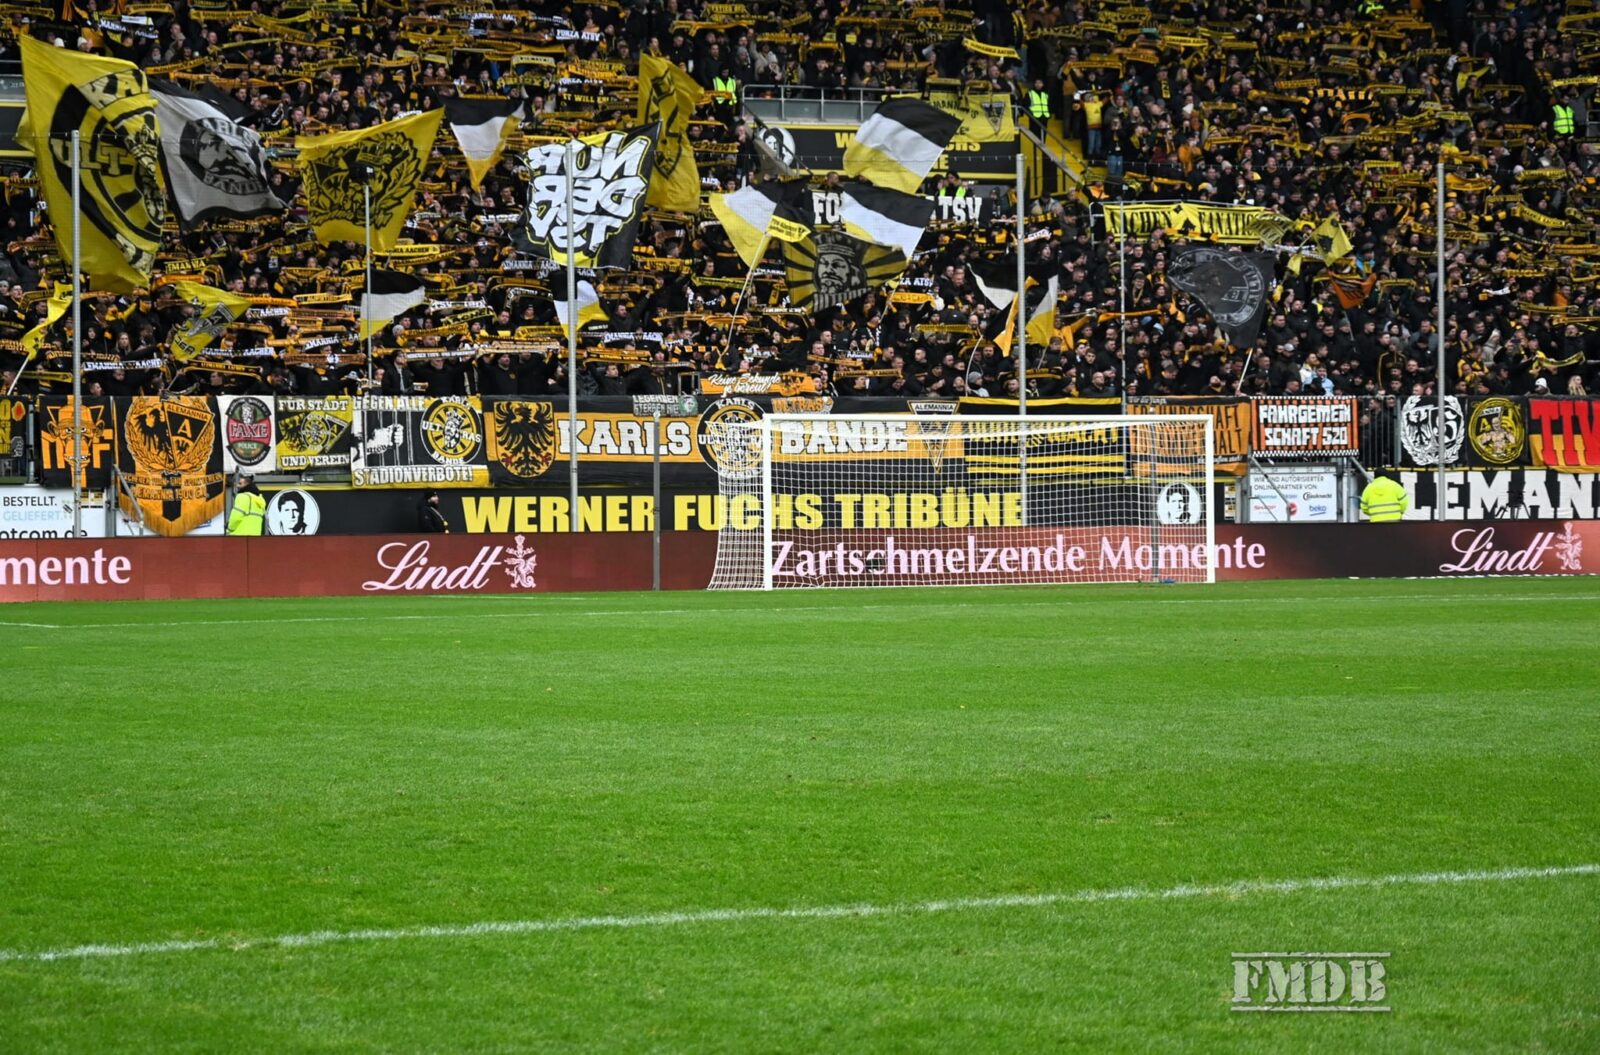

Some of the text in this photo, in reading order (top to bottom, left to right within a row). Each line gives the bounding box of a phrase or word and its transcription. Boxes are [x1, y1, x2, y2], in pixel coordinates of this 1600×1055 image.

[307, 399, 349, 412] STADT
[352, 394, 425, 411] GEGEN ALLE
[717, 397, 755, 410] KARLS
[914, 403, 954, 412] ALEMANNIA
[167, 403, 209, 420] ALEMANNIA
[229, 423, 268, 438] FAXE
[558, 420, 908, 456] KARLS BANDE
[1264, 427, 1320, 446] SCHAFT
[281, 455, 307, 467] UND
[309, 454, 350, 467] VEREIN
[353, 465, 474, 486] STADIONVERBOTE!
[1304, 483, 1317, 491] VON
[3, 495, 58, 507] BESTELLT.
[461, 486, 1022, 533] WERNER FUCHS TRIBÜNE
[772, 533, 1266, 577] Zartschmelzende Momente
[1439, 527, 1556, 573] Lindt
[361, 540, 504, 592] Lindt
